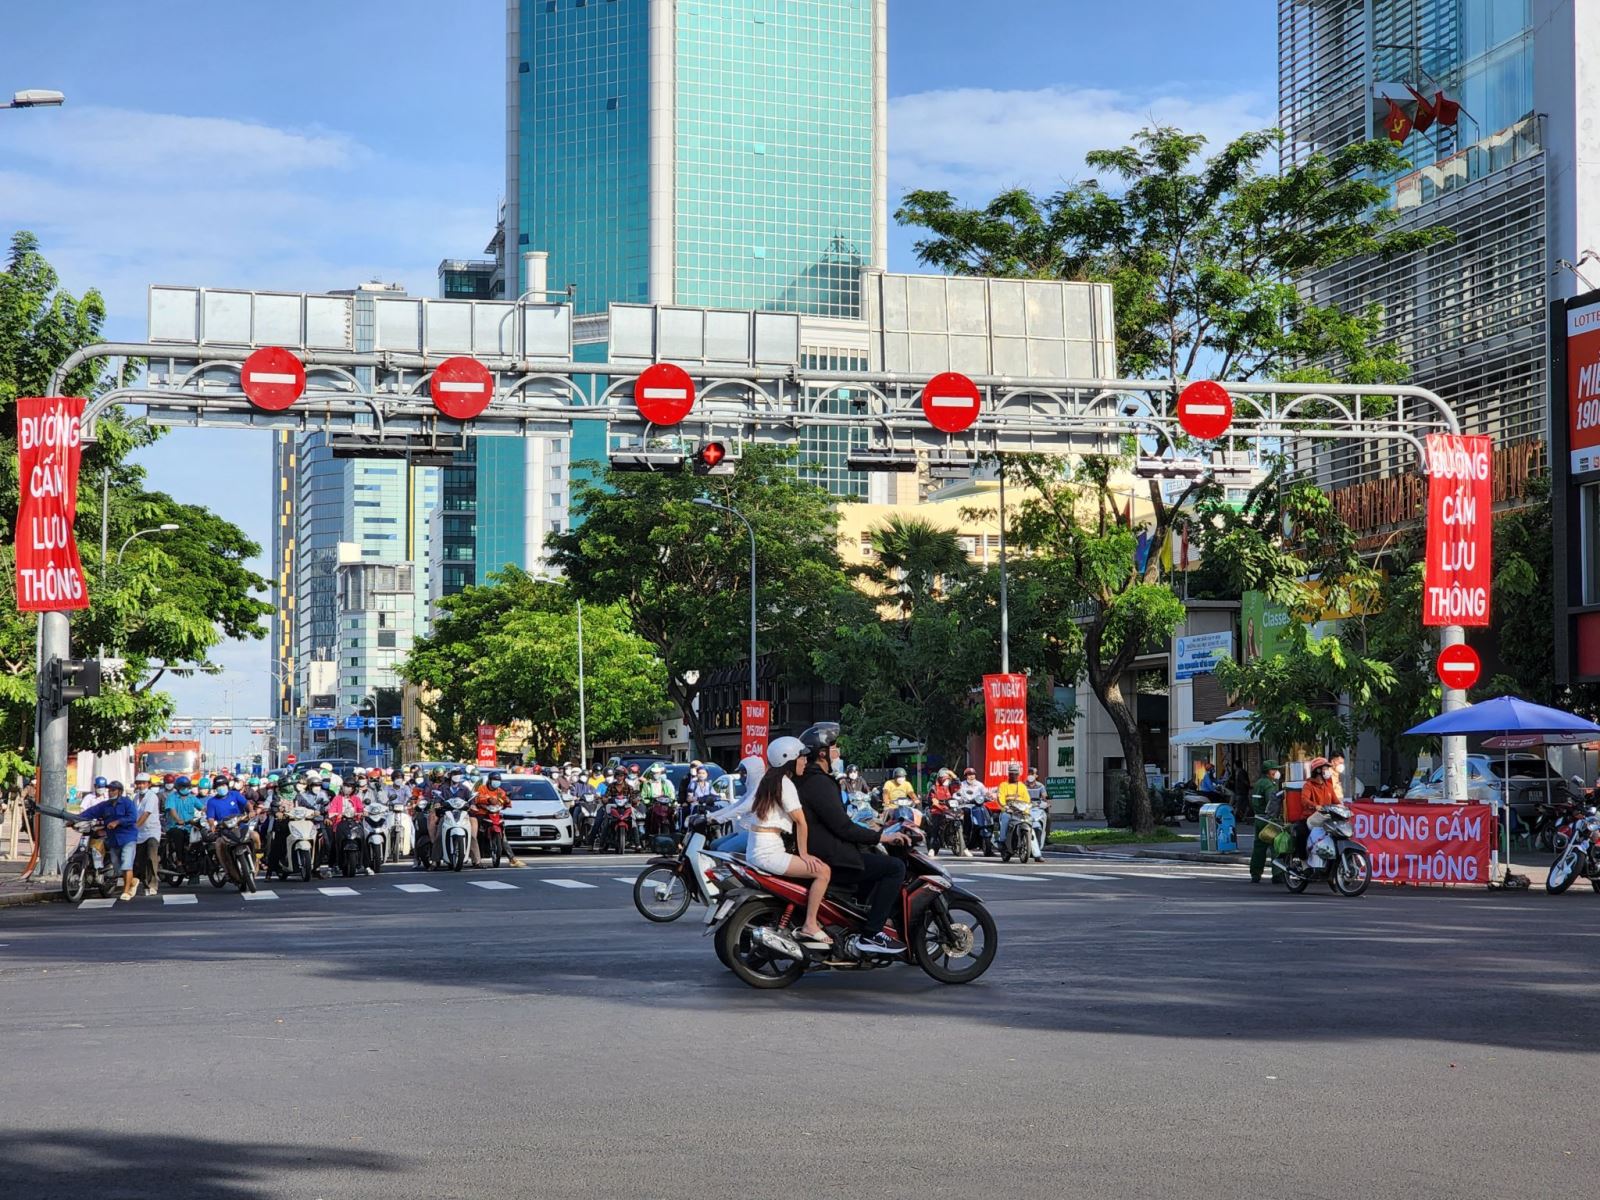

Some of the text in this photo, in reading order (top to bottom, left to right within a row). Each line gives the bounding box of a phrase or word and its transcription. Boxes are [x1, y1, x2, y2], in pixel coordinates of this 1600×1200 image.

[20, 406, 80, 450] ĐƯỜNG
[1576, 398, 1600, 430] 190
[1442, 486, 1476, 525] CẤM
[32, 516, 67, 550] LƯU
[1441, 539, 1476, 571] LƯU
[20, 560, 82, 602] THÔNG
[1429, 581, 1486, 617] THÔNG
[1262, 611, 1291, 628] Classes
[994, 708, 1024, 724] 7/5/2022
[993, 728, 1020, 751] CẤM
[1354, 808, 1481, 842] ĐƯỜNG CẤM
[1404, 849, 1478, 881] THÔNG
